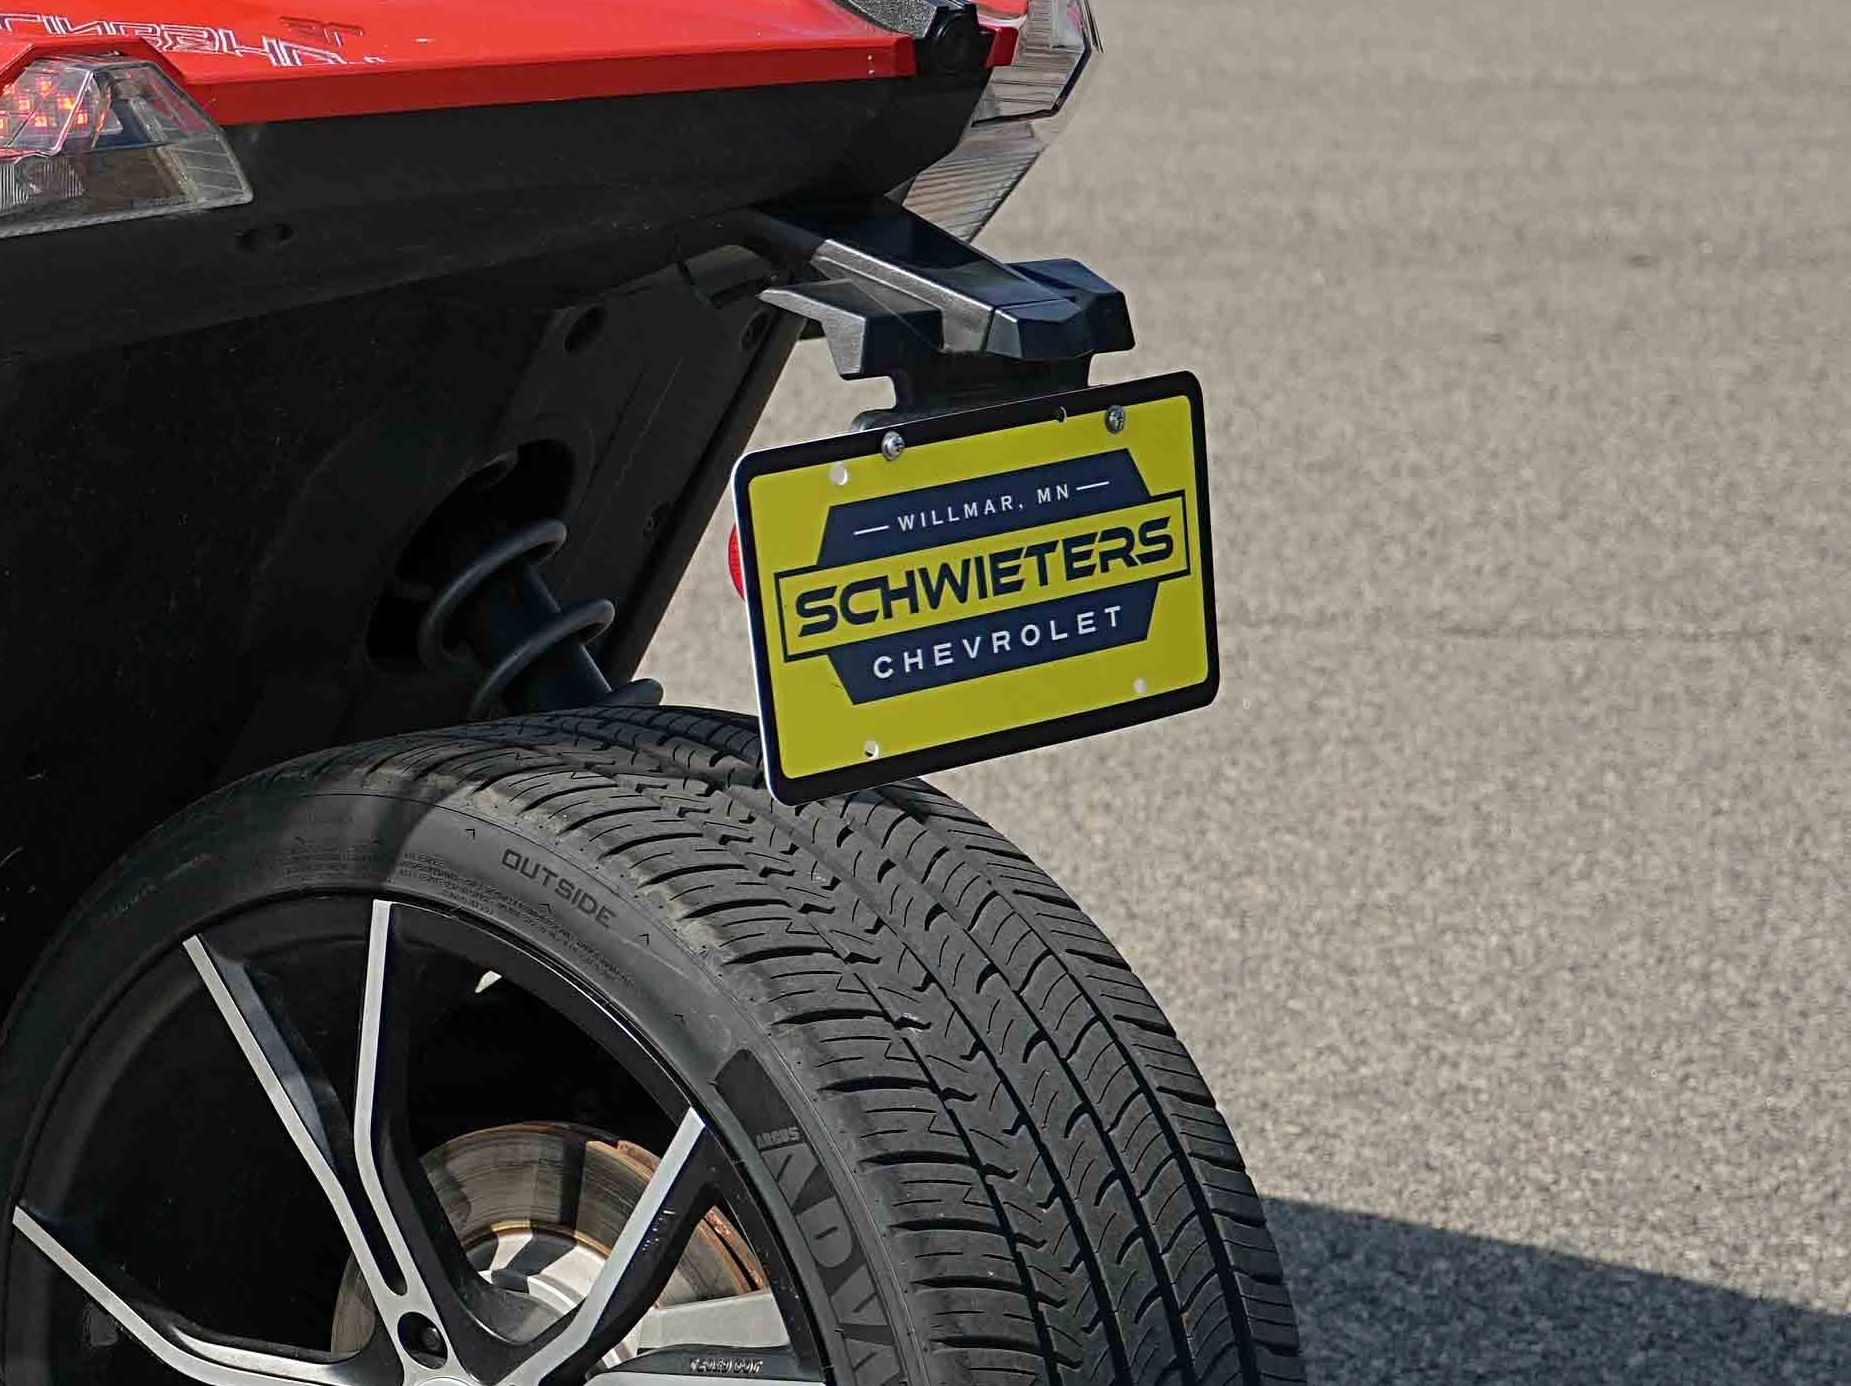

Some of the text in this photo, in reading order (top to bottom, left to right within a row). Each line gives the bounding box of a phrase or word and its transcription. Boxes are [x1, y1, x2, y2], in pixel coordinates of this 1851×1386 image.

[897, 482, 1072, 533] WILLMAR, MN
[796, 516, 1175, 638] SCHWIETERS
[872, 604, 1123, 680] CHEVROLET
[500, 847, 619, 929] OUTSIDE
